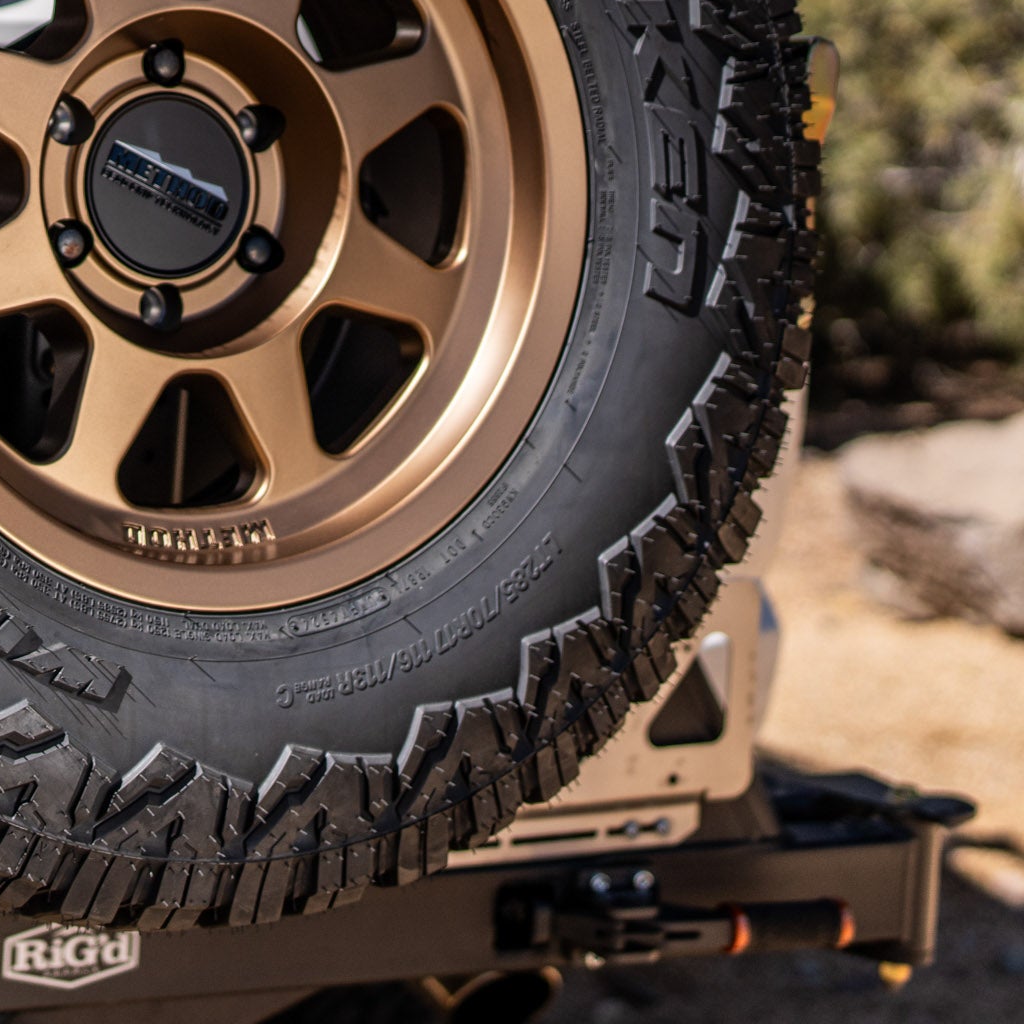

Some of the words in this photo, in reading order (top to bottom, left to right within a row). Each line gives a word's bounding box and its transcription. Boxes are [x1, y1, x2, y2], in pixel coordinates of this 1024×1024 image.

[106, 142, 229, 221] METHOD
[123, 517, 276, 551] METHOD
[438, 536, 467, 565] DOT
[434, 532, 563, 656] LT285/70R17
[337, 639, 432, 696] 116/113R
[277, 682, 295, 709] C
[294, 677, 333, 695] RANGE
[306, 687, 336, 704] LOAD
